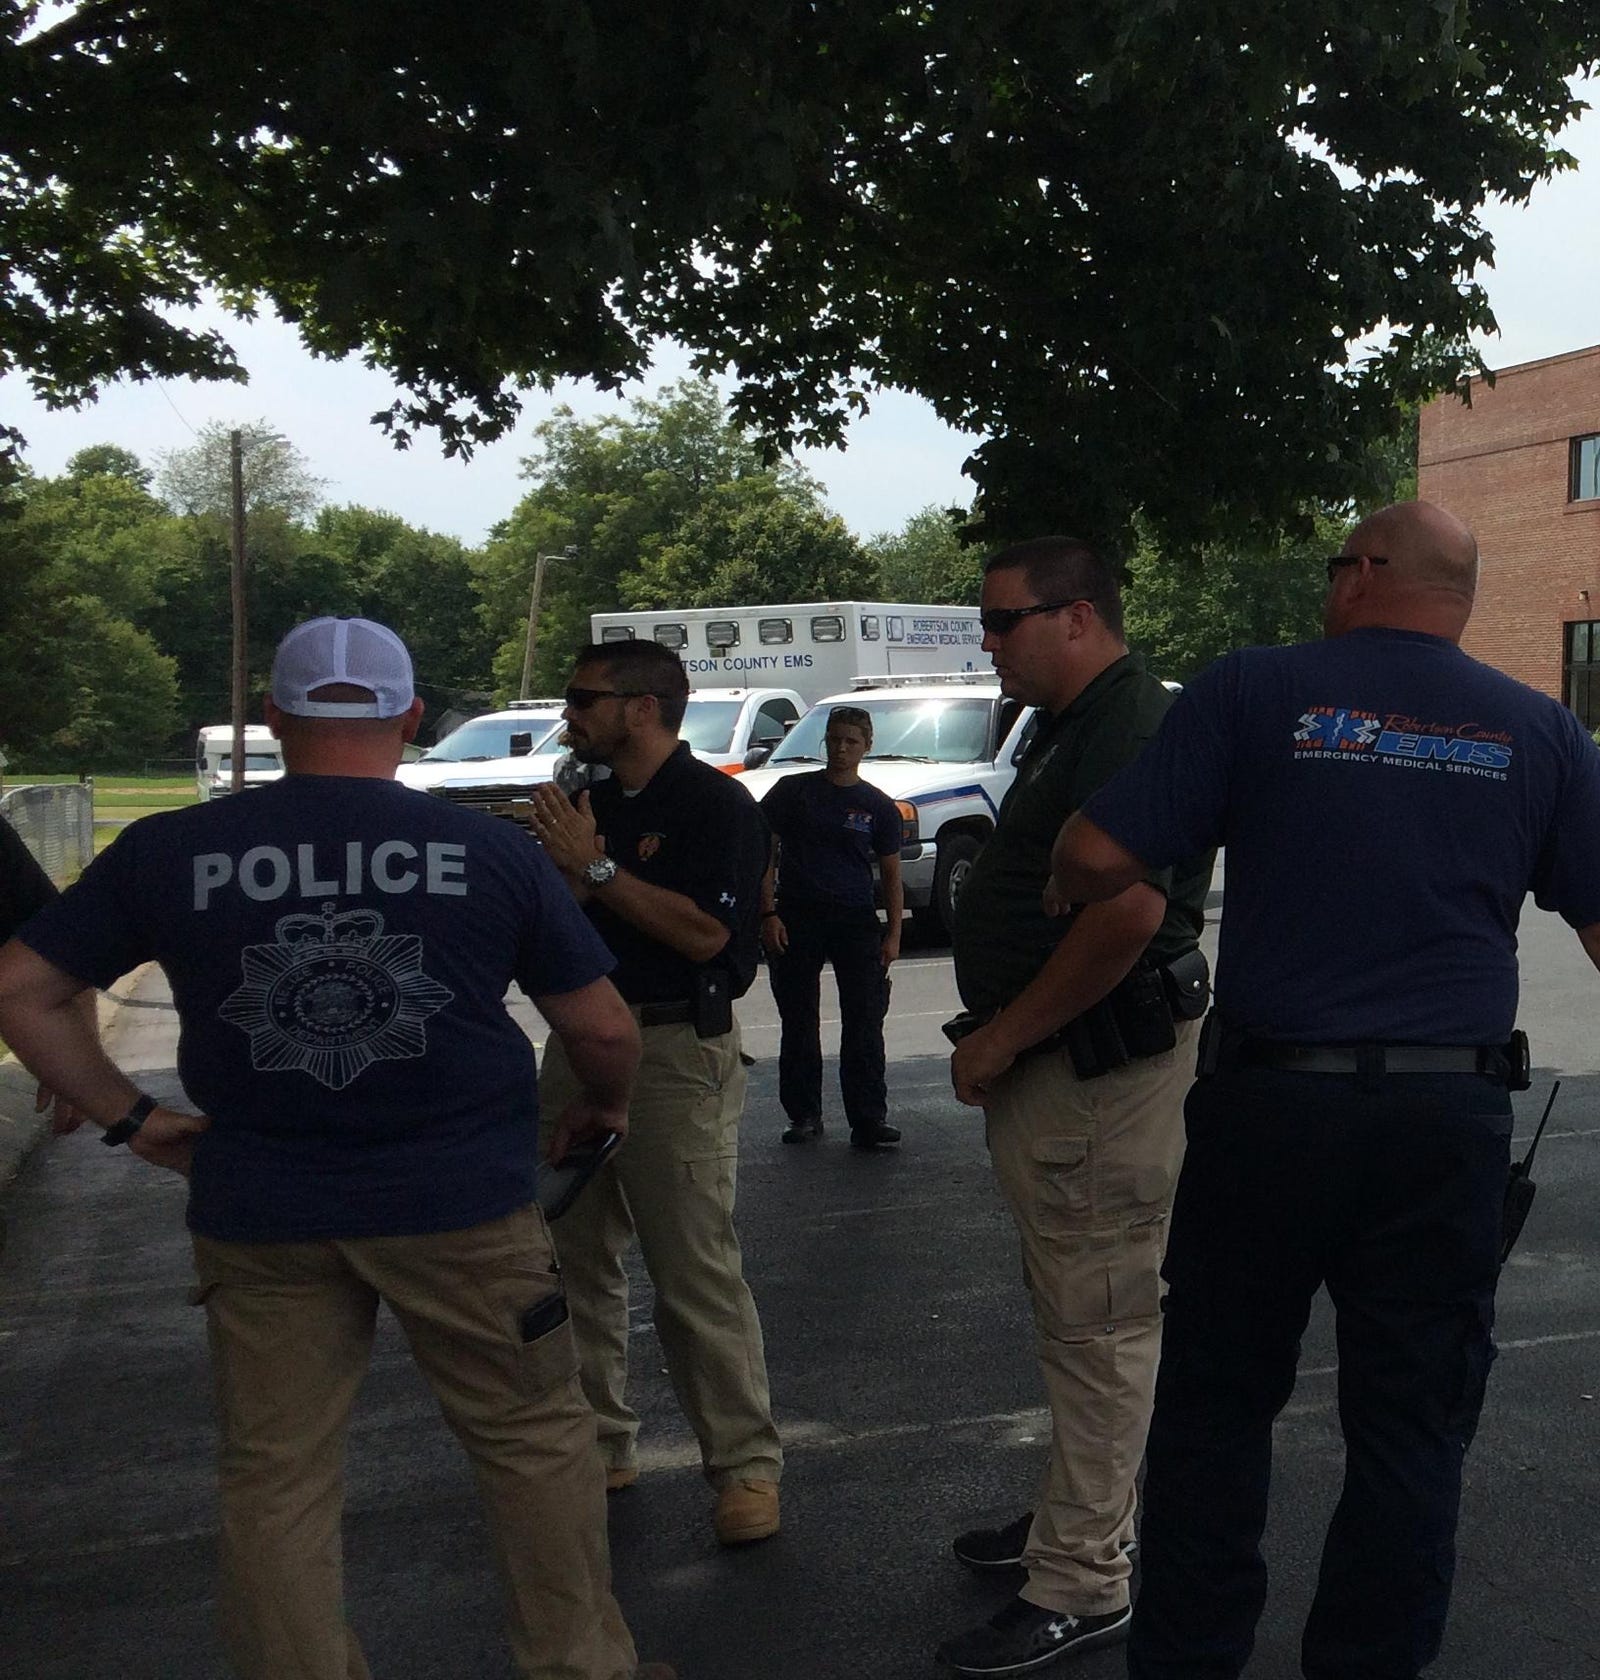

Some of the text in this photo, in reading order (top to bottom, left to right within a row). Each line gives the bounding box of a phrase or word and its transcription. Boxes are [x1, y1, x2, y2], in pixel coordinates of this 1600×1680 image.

[939, 633, 961, 645] MEDICAL
[951, 620, 973, 633] COUNTY
[723, 656, 778, 670] COUNTY
[784, 655, 813, 667] EMS
[1383, 714, 1514, 743] Robertson County
[1374, 731, 1512, 768] EMS
[1294, 750, 1508, 781] EMERGENCY MEDICAL SERVICES
[193, 840, 467, 910] POLICE
[275, 961, 392, 1004] BELIZE POLICE
[287, 1017, 382, 1045] DEPARTMENT
